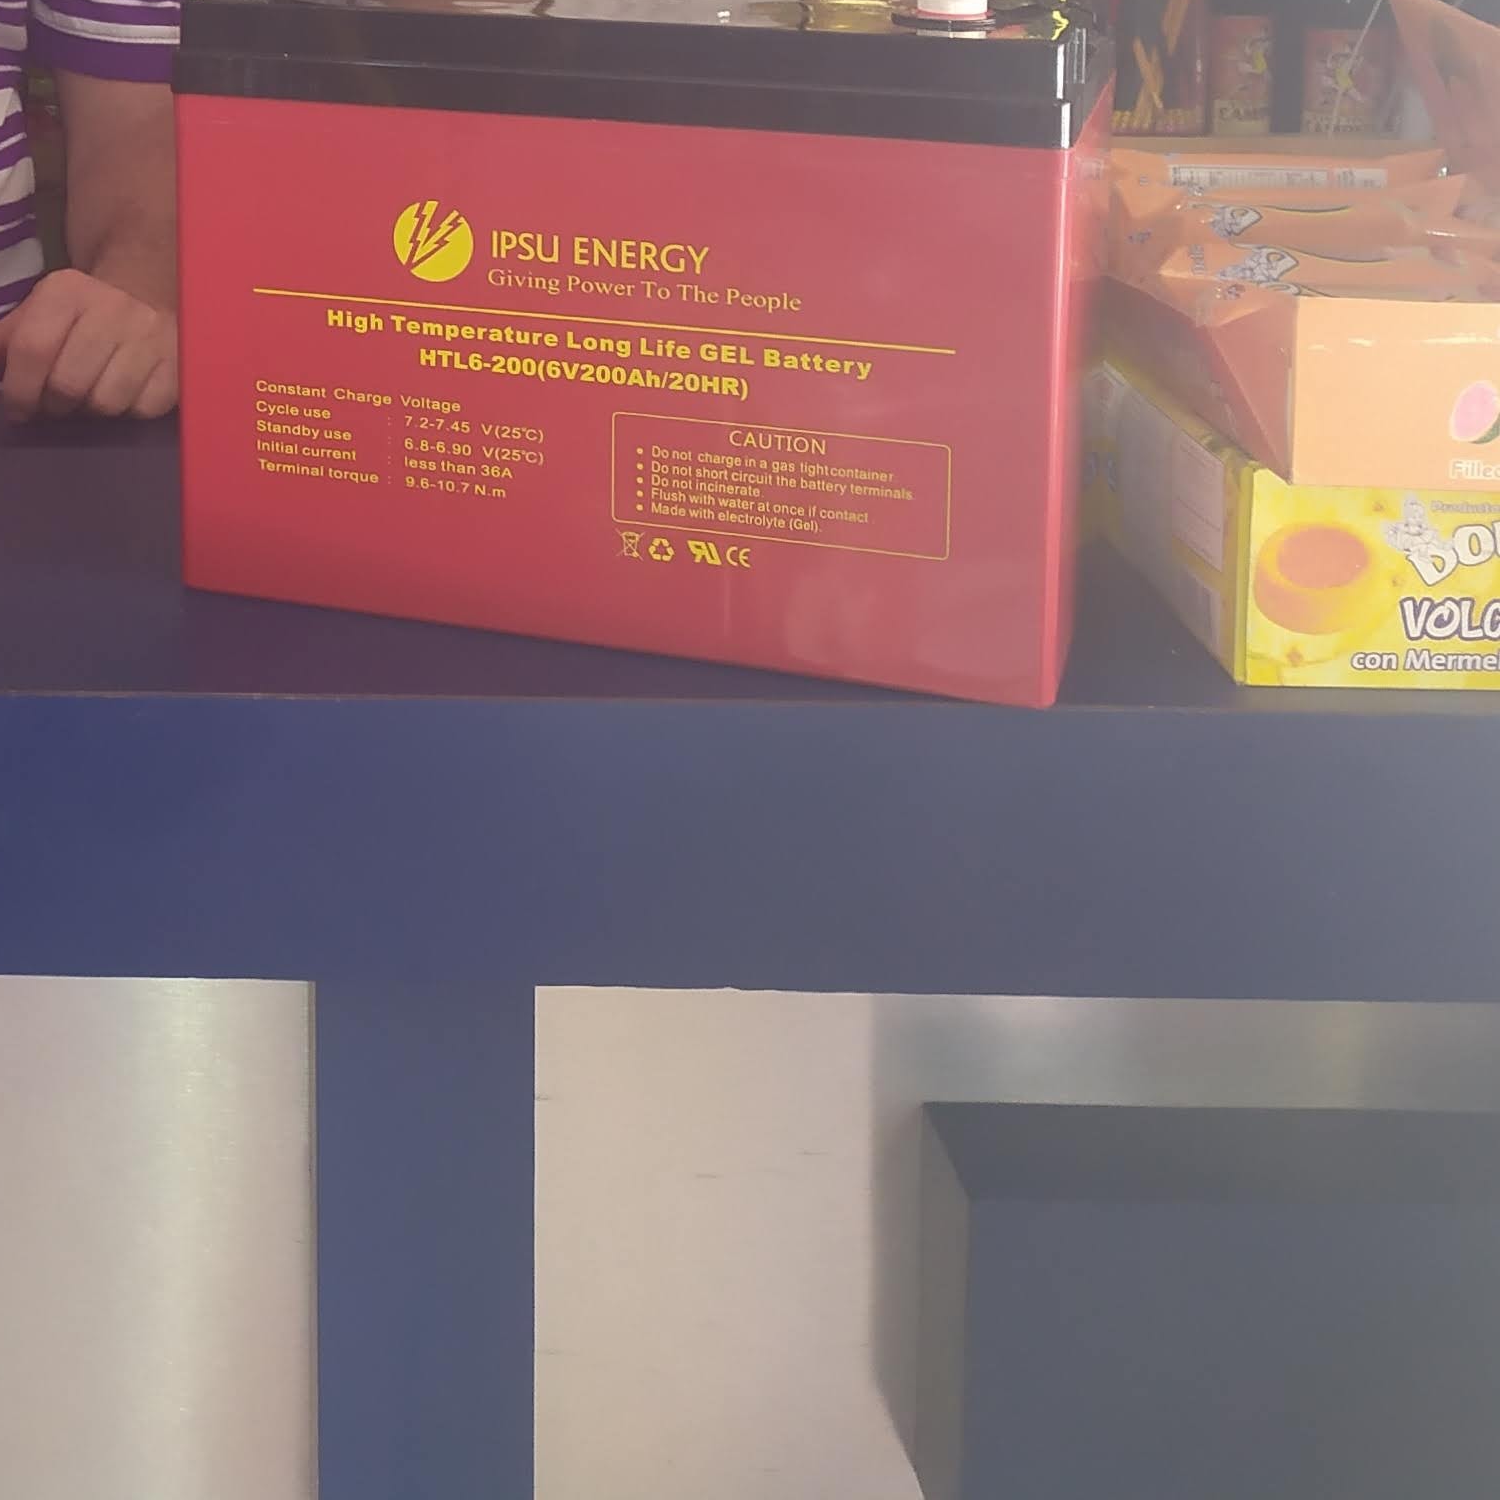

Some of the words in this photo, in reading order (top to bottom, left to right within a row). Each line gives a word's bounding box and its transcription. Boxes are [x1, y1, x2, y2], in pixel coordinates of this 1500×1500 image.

[492, 230, 559, 263] IPSU
[574, 236, 709, 275] ENERGY
[488, 268, 560, 295] Giving
[567, 275, 636, 297] Power
[640, 281, 671, 300] To
[676, 284, 719, 304] The
[726, 288, 802, 314] People
[327, 309, 383, 334] High
[390, 315, 559, 347] Temperature
[566, 331, 631, 358] Long
[640, 337, 691, 359] Life
[699, 343, 755, 365] GEL
[763, 348, 872, 380] Battery
[419, 349, 748, 400] HTL6-200(6V200Ah/20HR)
[256, 380, 327, 398] Constant
[333, 387, 392, 407] Charge
[400, 395, 461, 414] Voltage
[256, 400, 300, 416] Cycle
[303, 408, 331, 419] use
[404, 415, 471, 434] 7.2-7.45
[729, 430, 826, 455] CAUTION
[1352, 652, 1398, 669] con
